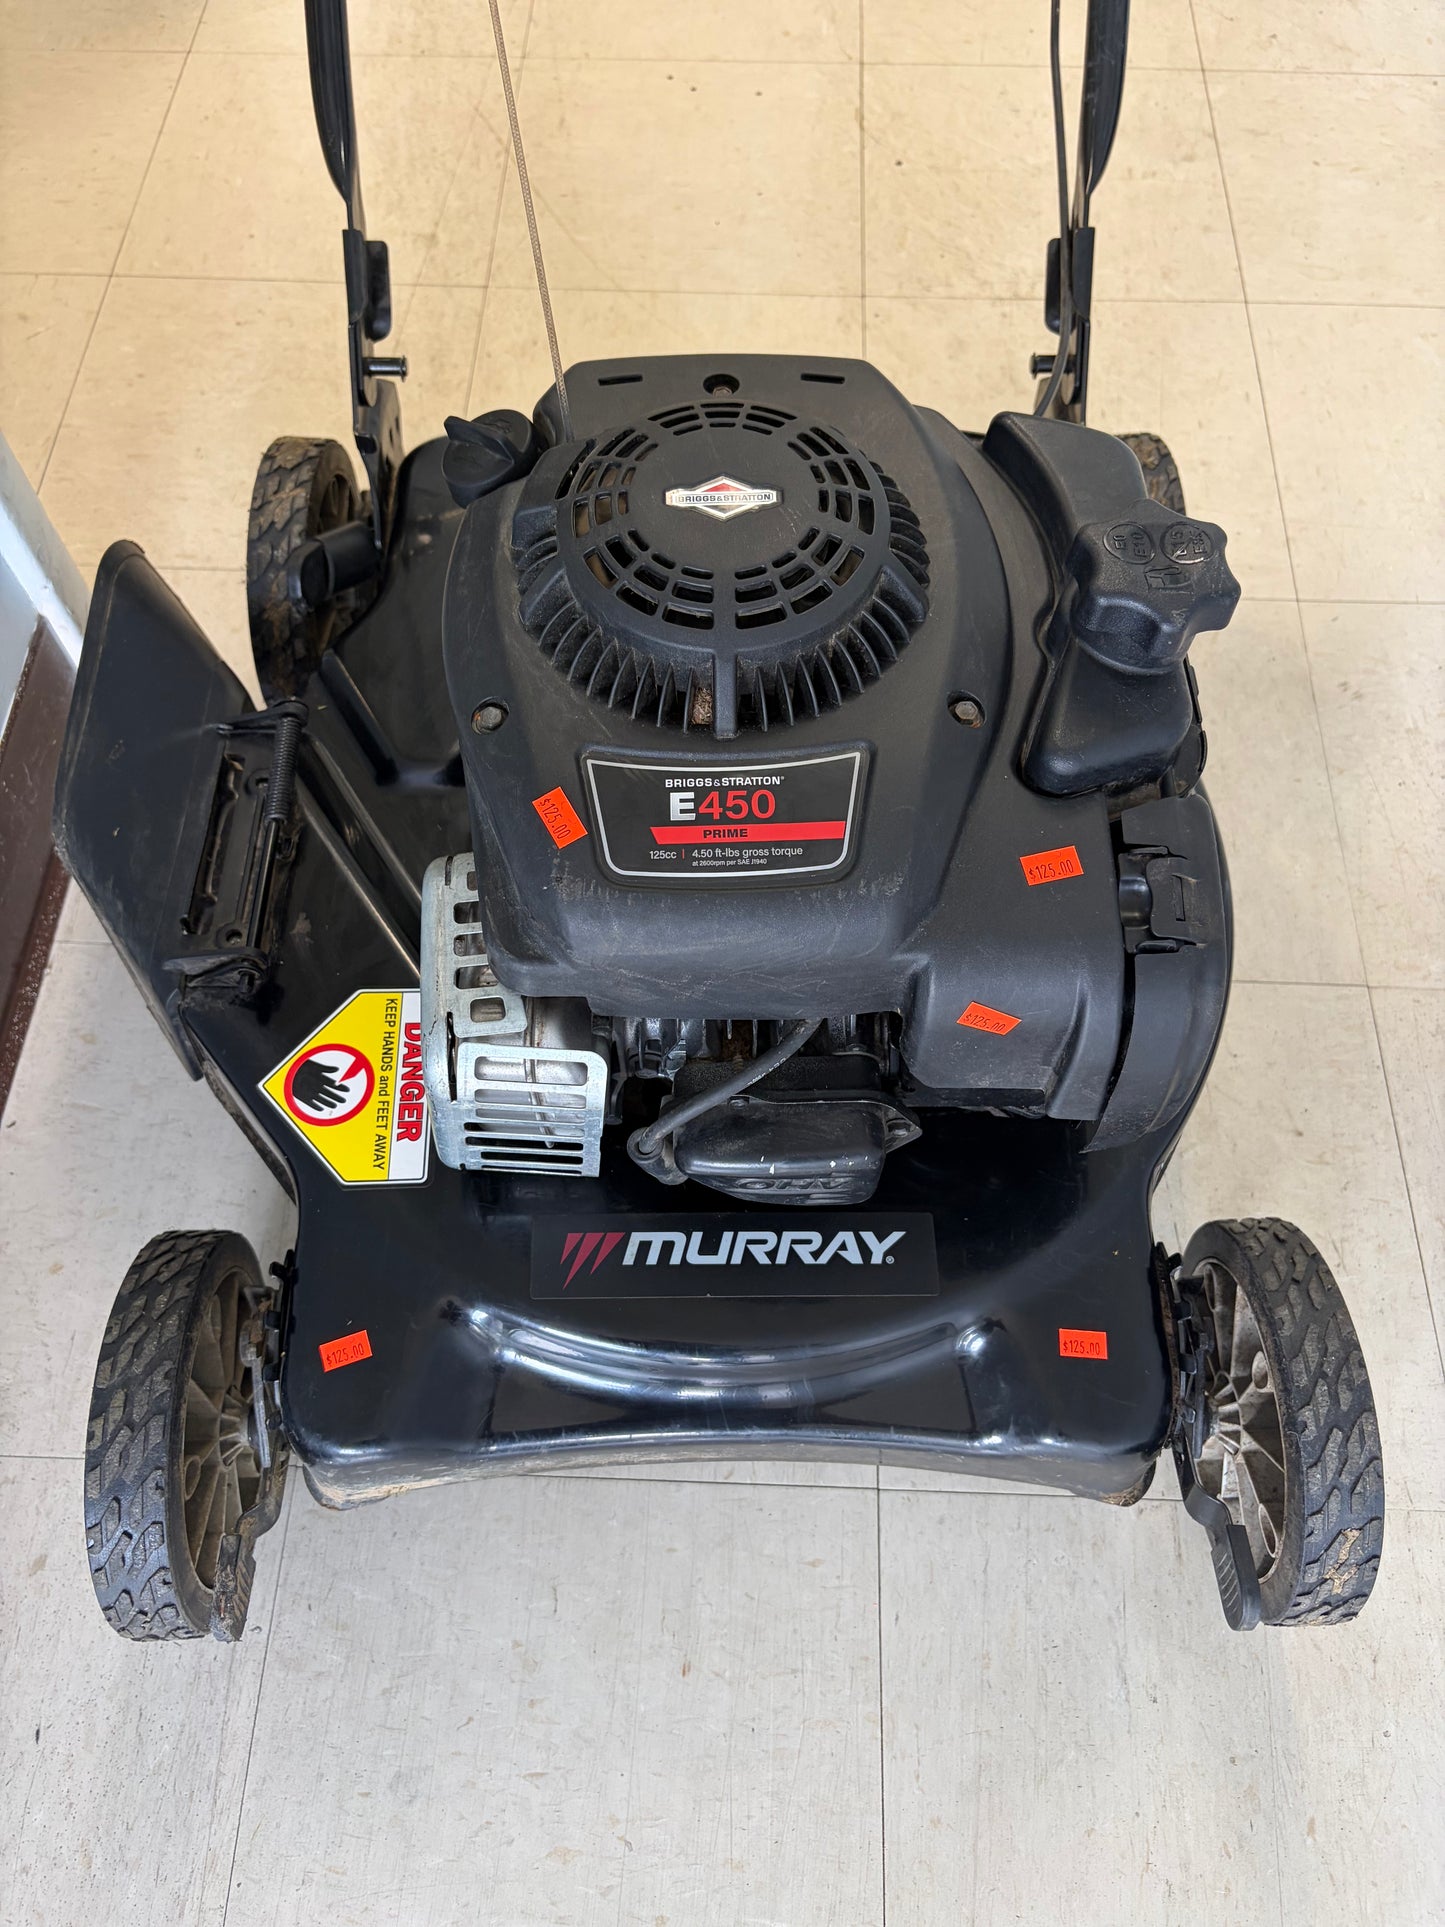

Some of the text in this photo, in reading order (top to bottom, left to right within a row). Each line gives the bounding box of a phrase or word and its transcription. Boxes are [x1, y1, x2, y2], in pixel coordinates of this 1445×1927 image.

[678, 493, 772, 503] BRIGGS&STRATTON
[669, 789, 776, 821] E450
[539, 798, 572, 840] $125.00
[703, 828, 749, 839] PRIME
[650, 847, 803, 860] 125cc 4.50 ft-lbs gross torque
[726, 860, 736, 868] per
[737, 858, 750, 866] SAE
[1028, 859, 1074, 882] $125.00
[963, 1013, 1007, 1032] $125.00
[373, 998, 398, 1170] KEEP HANDS and FEET AWAY
[397, 1022, 426, 1143] DANGER
[326, 1343, 365, 1366] $125.00
[1063, 1340, 1101, 1355] $125.00
